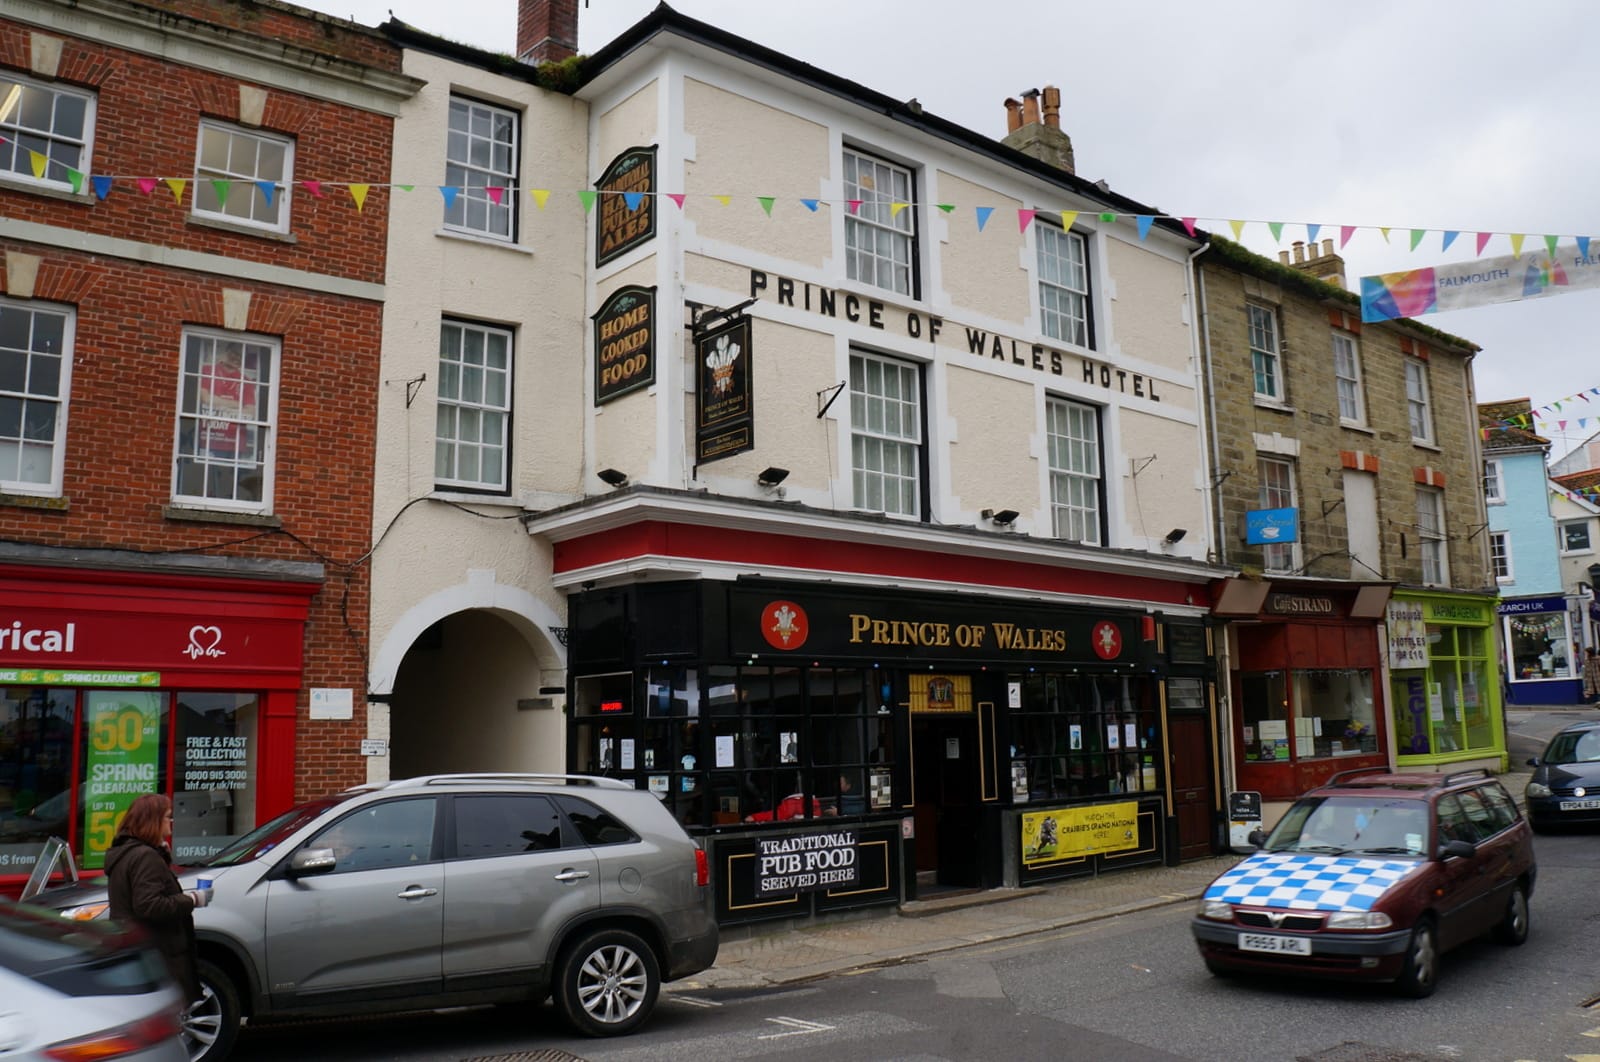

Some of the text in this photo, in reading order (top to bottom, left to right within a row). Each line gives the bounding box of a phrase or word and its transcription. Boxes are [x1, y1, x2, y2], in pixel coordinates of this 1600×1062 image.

[600, 212, 649, 255] ALES
[1575, 253, 1600, 267] FAL
[1438, 269, 1510, 288] FALMOUTH
[601, 304, 648, 340] HOME
[750, 269, 1160, 402] PRINCE OF WALES HOTEL
[601, 328, 648, 363] COOKED
[601, 353, 647, 386] FOOD
[1291, 597, 1332, 613] STRAND
[0, 621, 75, 652] rical
[849, 614, 1066, 651] PRINCE OF WALES
[186, 737, 247, 748] FREE & FAST
[185, 749, 246, 760] COLLECTION
[92, 763, 154, 782] SPRING
[185, 770, 247, 780] 0800 915 3000
[91, 782, 153, 794] CLEARANCE
[185, 781, 246, 792] bhf.org.uk/free
[92, 802, 115, 811] UP TO
[1091, 821, 1111, 831] GRAND
[1111, 818, 1136, 827] NATIONAL
[176, 846, 207, 857] SOFAS
[760, 832, 855, 854] TRADITIONAL
[11, 854, 36, 865] from
[760, 848, 855, 875] PUB FOOD
[761, 868, 855, 891] SERVED HERE
